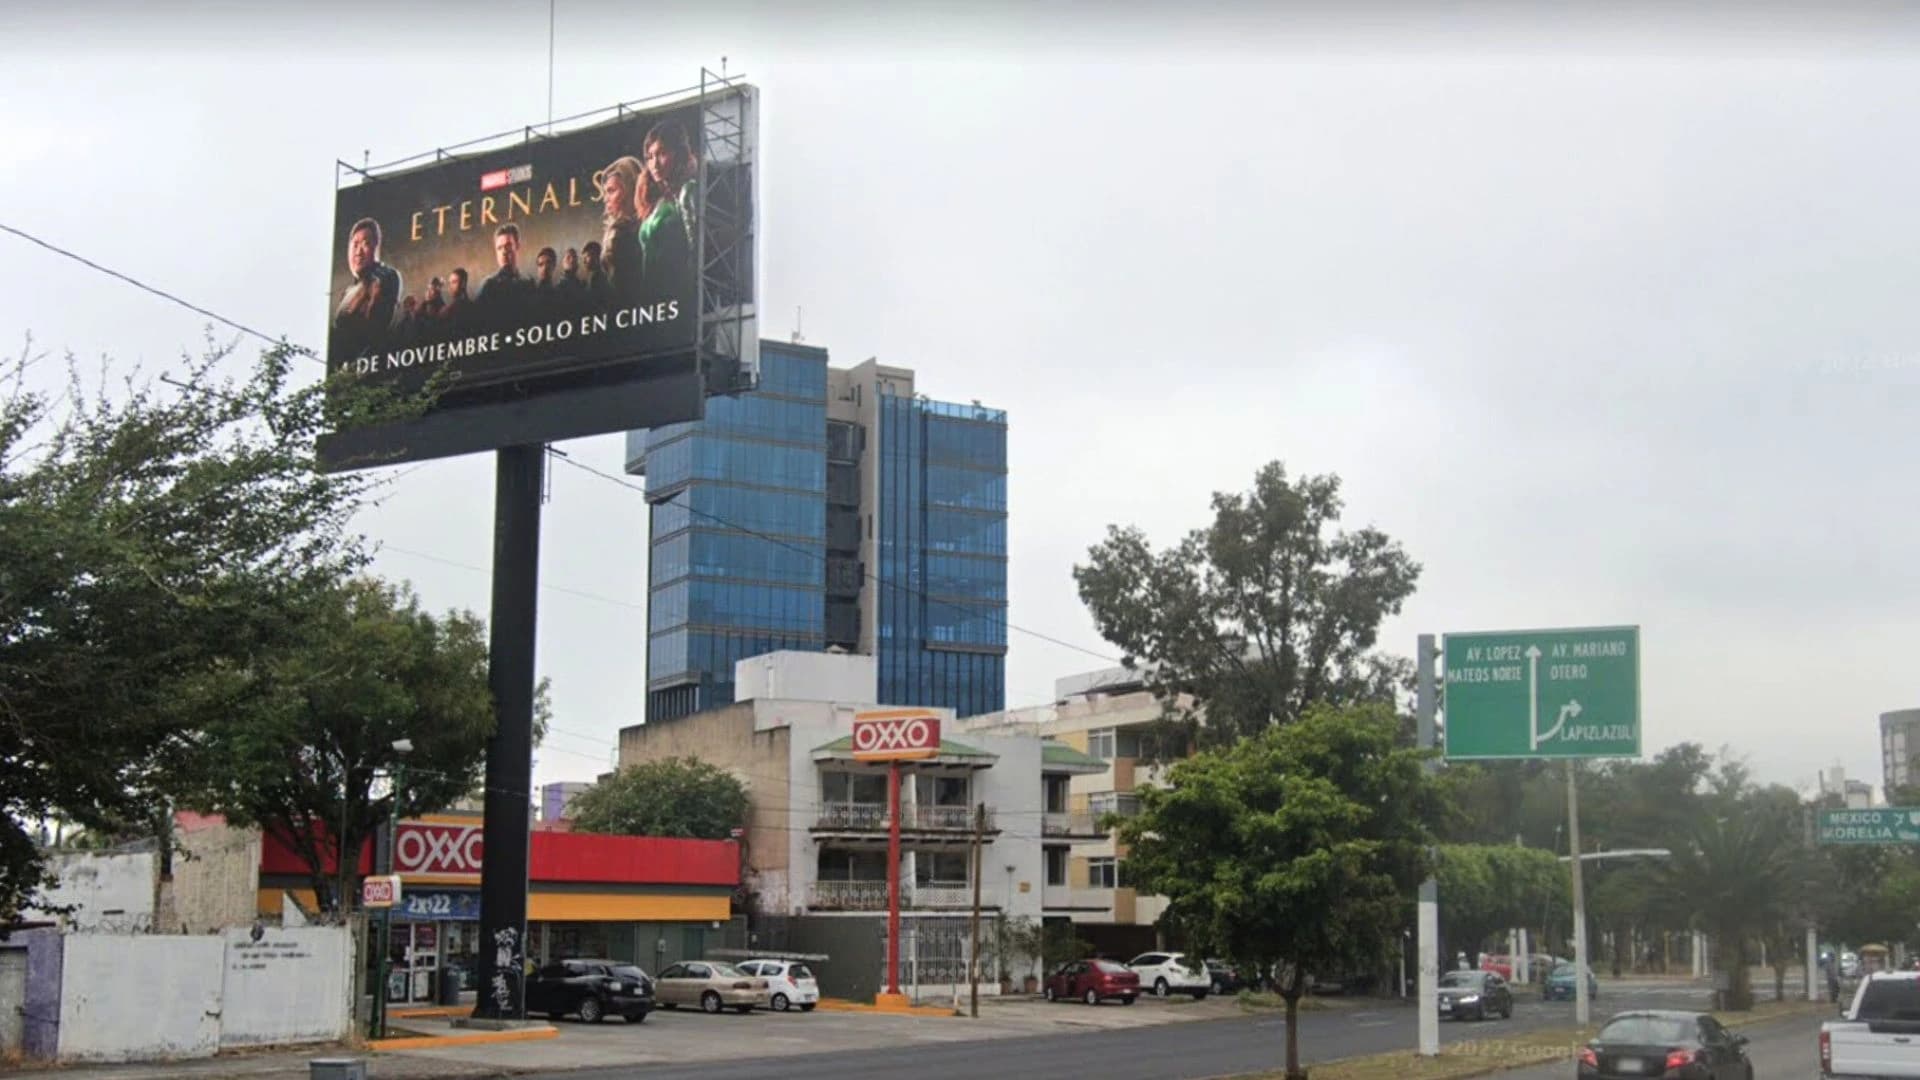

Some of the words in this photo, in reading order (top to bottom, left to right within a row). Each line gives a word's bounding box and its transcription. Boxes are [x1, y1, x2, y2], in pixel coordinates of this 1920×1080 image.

[411, 169, 606, 241] ETERNALS
[356, 355, 380, 375] DE
[387, 332, 501, 370] NOVIEMBRE
[515, 319, 573, 347] SOLO
[581, 313, 609, 335] EN
[616, 299, 680, 329] CINES
[1466, 647, 1484, 662] AV.
[1487, 645, 1521, 661] LOPEZ
[1551, 643, 1570, 657] AV.
[1573, 640, 1627, 656] MARIANO
[1447, 668, 1489, 683] MATEOS
[1492, 666, 1523, 681] NORTE
[1550, 664, 1588, 680] OTERO
[856, 719, 929, 752] OXXO
[1829, 812, 1882, 825] MEXICO
[1822, 827, 1893, 840] MORELIA
[397, 826, 483, 874] OXXO
